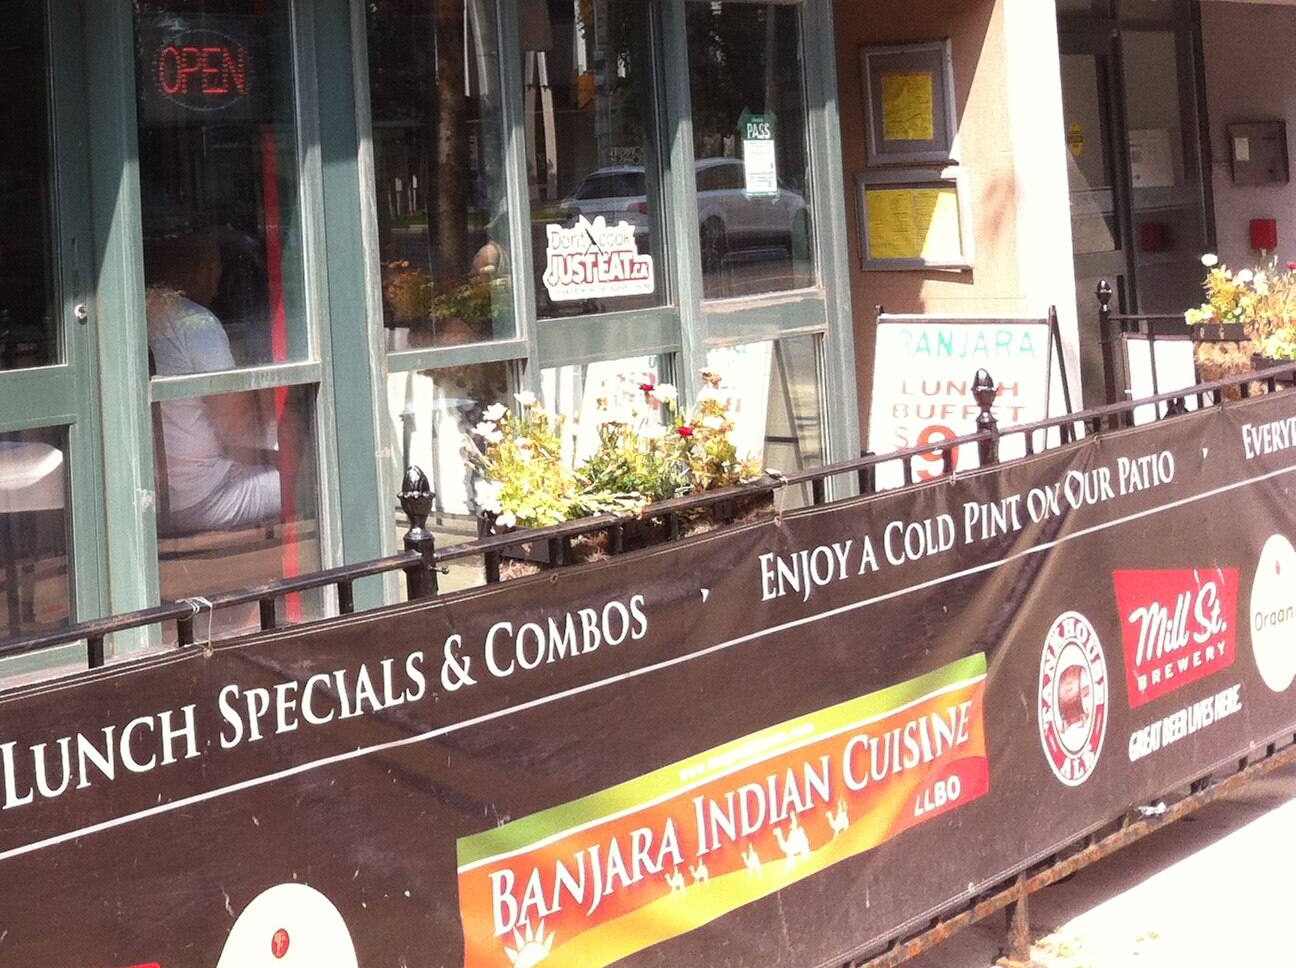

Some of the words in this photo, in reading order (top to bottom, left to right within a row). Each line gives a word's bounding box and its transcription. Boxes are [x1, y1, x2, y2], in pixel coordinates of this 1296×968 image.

[160, 46, 247, 93] OPEN
[746, 123, 771, 139] PASS
[898, 329, 1035, 359] BANJARA
[901, 380, 1019, 398] LUNH
[758, 536, 854, 602] ENJOY
[858, 534, 880, 576] A
[883, 516, 955, 566] COLD
[963, 494, 1021, 545] PINT
[1026, 482, 1061, 524] ON
[1063, 465, 1116, 511] OUR
[1116, 449, 1176, 495] PATIO
[1128, 590, 1192, 667] Mill
[1192, 581, 1227, 644] St.
[217, 650, 426, 750] SPECIALS
[439, 633, 478, 692] &
[484, 594, 649, 679] COMBOS
[1136, 640, 1227, 692] BREWERY
[488, 816, 685, 938] BANJARA
[693, 754, 831, 857] INDIAN
[842, 700, 974, 792] CUISINE
[913, 776, 961, 817] LLBO
